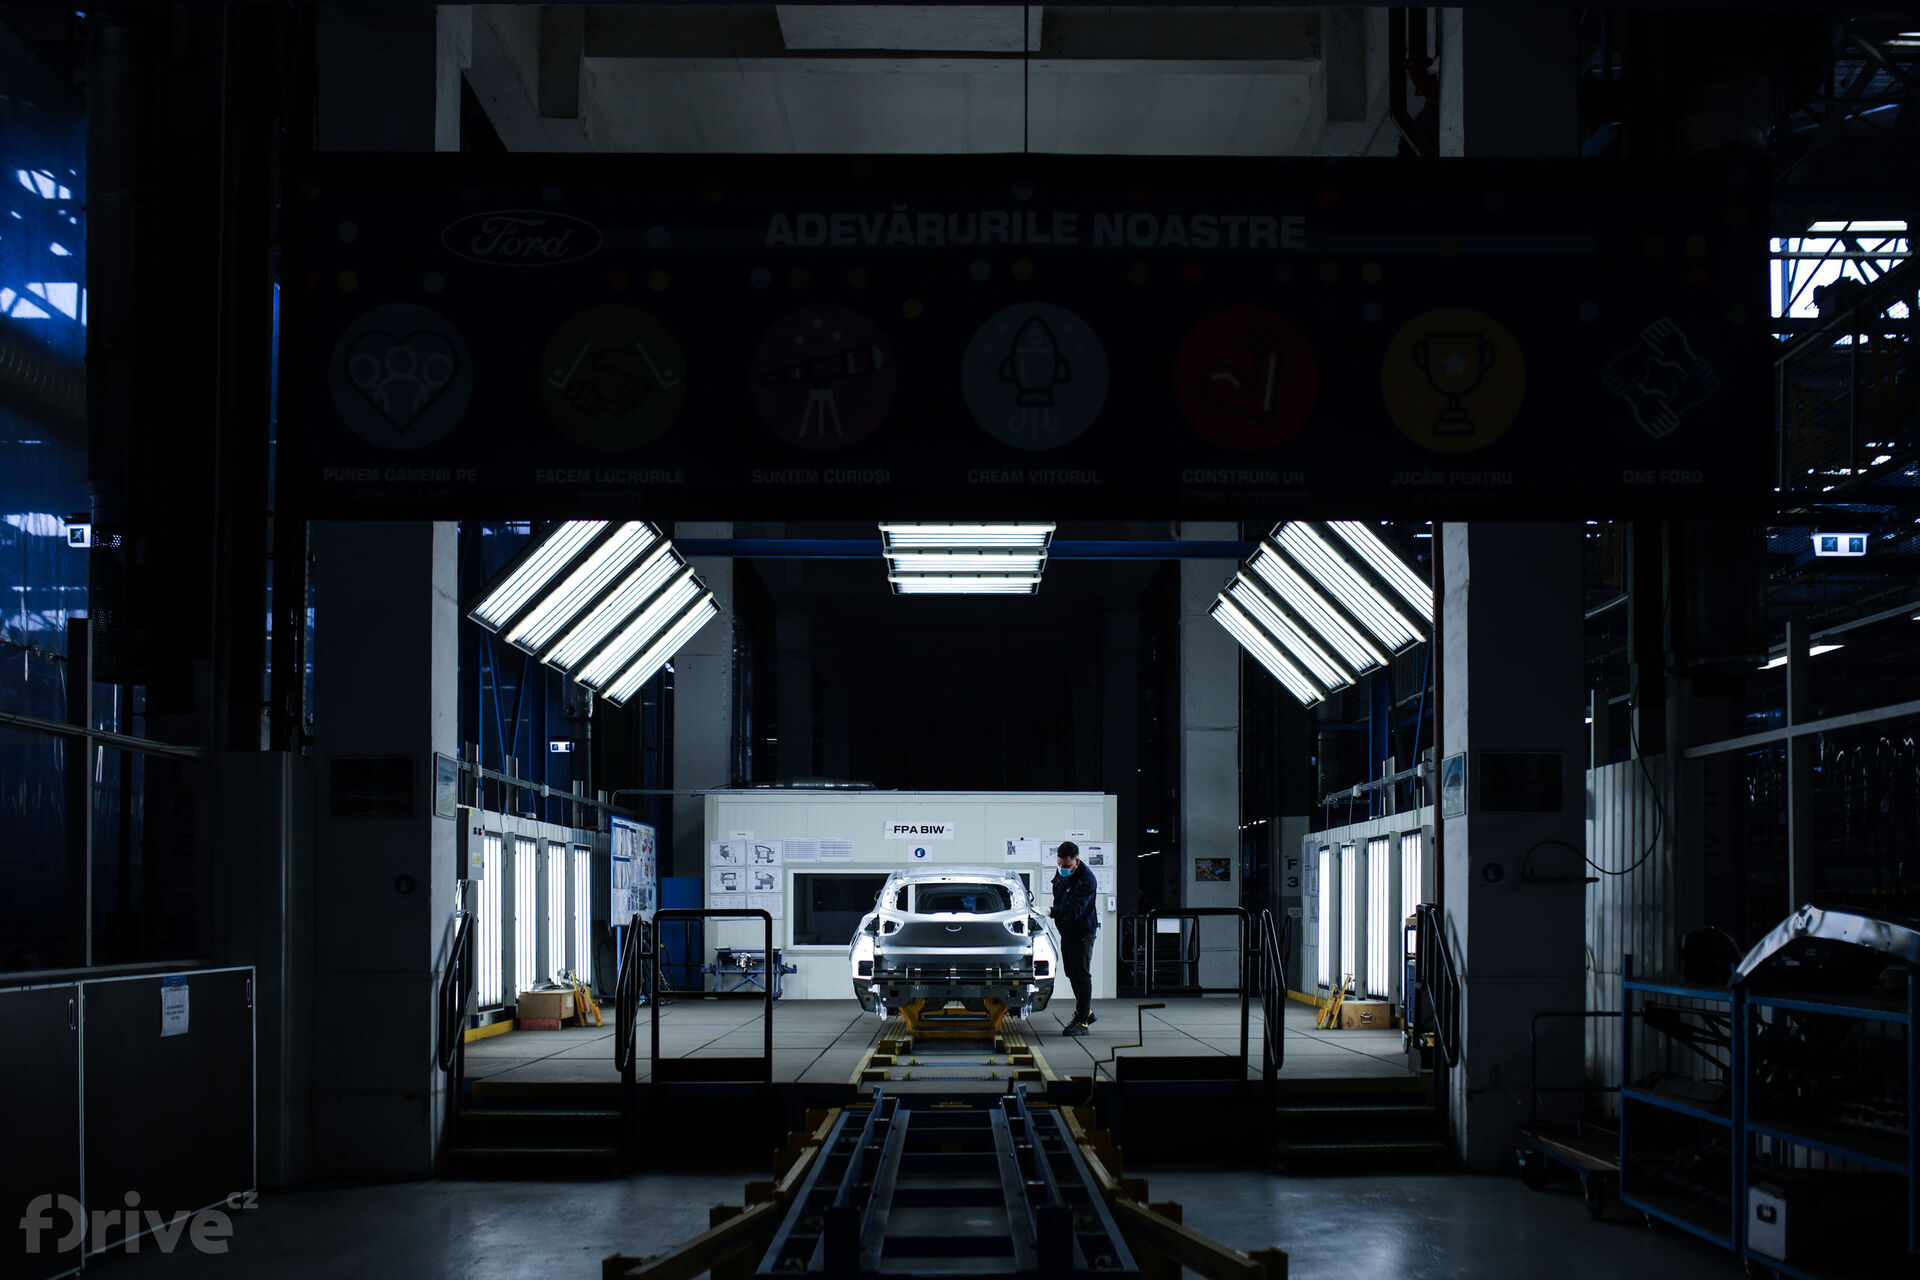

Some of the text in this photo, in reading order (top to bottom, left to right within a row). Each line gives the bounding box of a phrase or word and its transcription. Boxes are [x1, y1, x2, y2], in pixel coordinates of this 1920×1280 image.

[764, 203, 1307, 249] ADEVĂRURILE NOASTRE
[471, 216, 574, 257] Ford
[323, 467, 478, 483] PUNEM OAMENII PE
[535, 468, 685, 484] FACEM LUCRURILE
[751, 468, 819, 484] SUNTEM
[1028, 468, 1102, 484] VIITORUL
[1182, 468, 1305, 485] CONSTRUIM UN
[1390, 466, 1513, 486] JUCĂM PENTRU
[1622, 469, 1704, 484] ONE FORD
[893, 825, 945, 834] FPA BIW
[1287, 859, 1298, 870] F
[1287, 876, 1299, 888] 3
